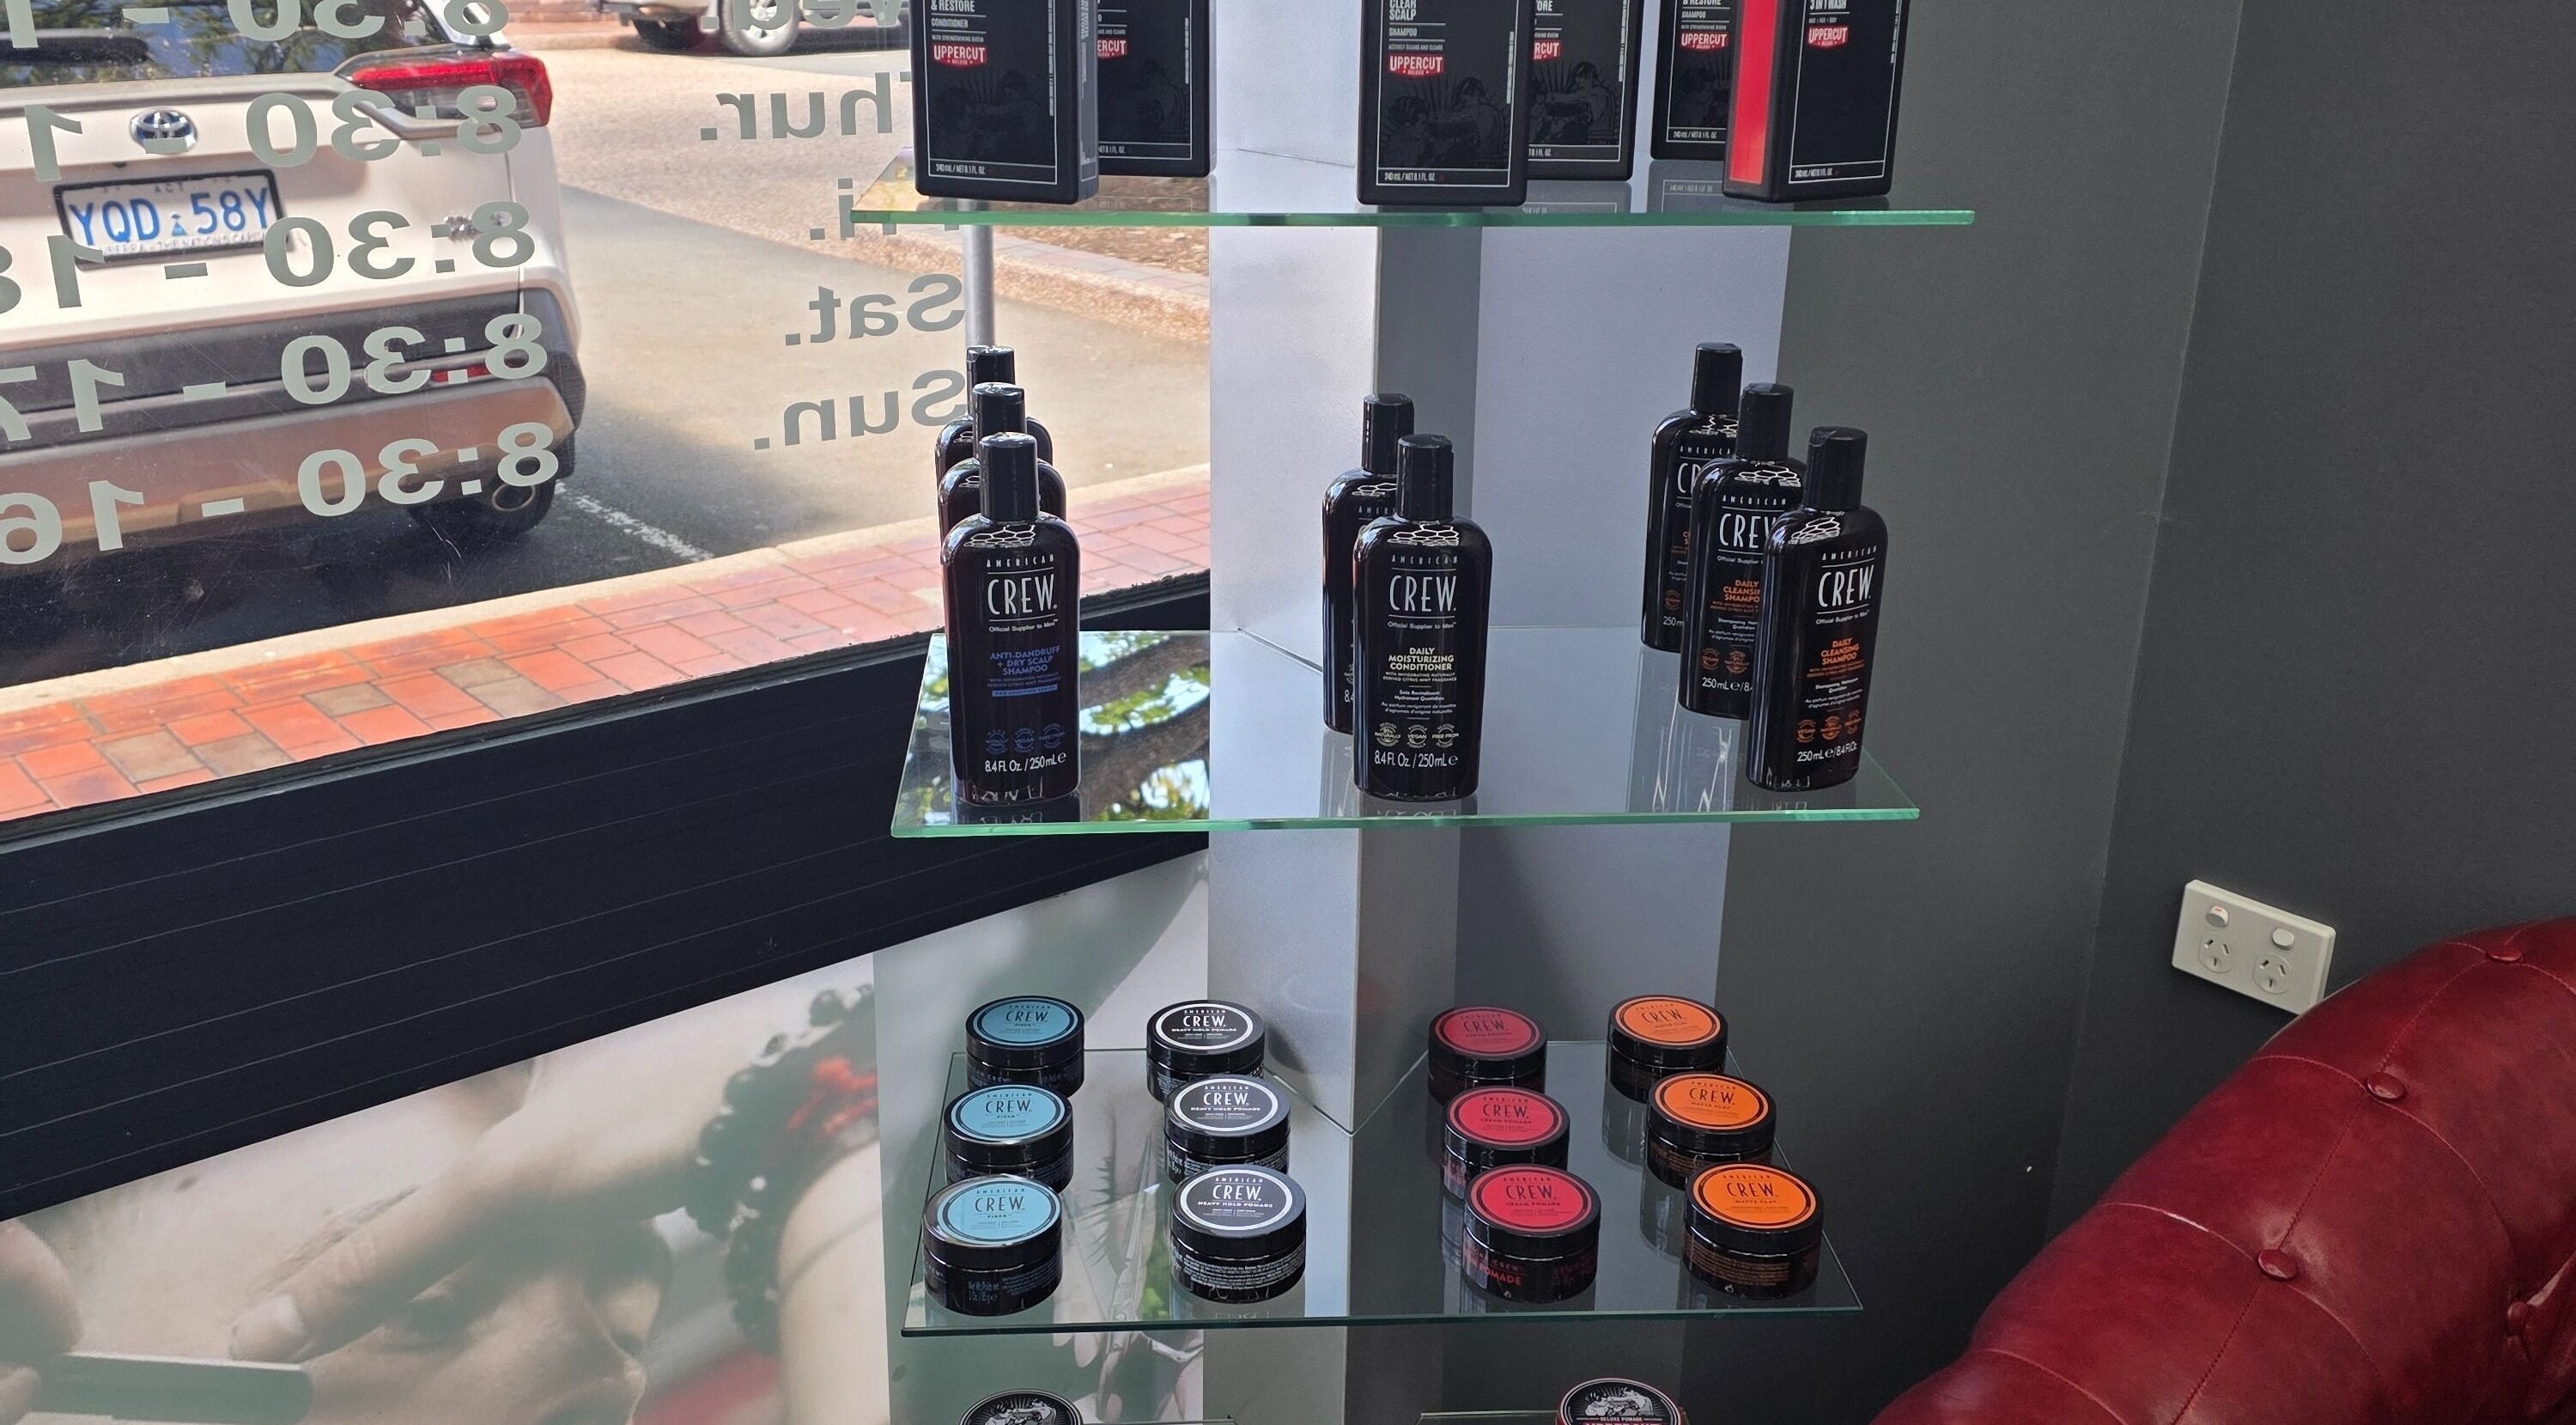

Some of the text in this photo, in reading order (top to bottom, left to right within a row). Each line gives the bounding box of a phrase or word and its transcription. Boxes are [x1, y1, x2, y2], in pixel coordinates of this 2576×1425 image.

[939, 0, 975, 12] RESTORE
[1388, 9, 1417, 21] SCALP
[1388, 27, 1418, 37] SHAMPOO
[1808, 27, 1848, 44] UPPERCUT
[1681, 33, 1728, 47] UPPERCUT
[1097, 40, 1127, 55] ERCUT
[1534, 42, 1560, 57] RCUT
[933, 45, 986, 64] UPPERCUT
[1389, 56, 1443, 73] UPPERCUT
[1680, 445, 1730, 455] AMERICA
[1722, 494, 1786, 506] AMERICAN
[1821, 545, 1877, 561] AMERICAN
[987, 553, 1054, 568] AMERICAN
[1391, 554, 1458, 565] AMERICAN
[1735, 579, 1759, 588] DAILY
[1724, 594, 1760, 603] SHAMPO
[1832, 637, 1853, 649] DAILY
[990, 645, 1060, 661] ANTI-DANDRUFF
[1409, 647, 1436, 655] DAILY
[1820, 642, 1860, 658] CLEANSING
[1006, 659, 1025, 667] DRY
[1027, 655, 1054, 666] SCALP
[1388, 655, 1455, 663] MOISTURIZING
[1822, 651, 1857, 666] SHAMPOO
[1002, 664, 1048, 675] SHAMPOO
[1389, 662, 1453, 671] CONDITIONER
